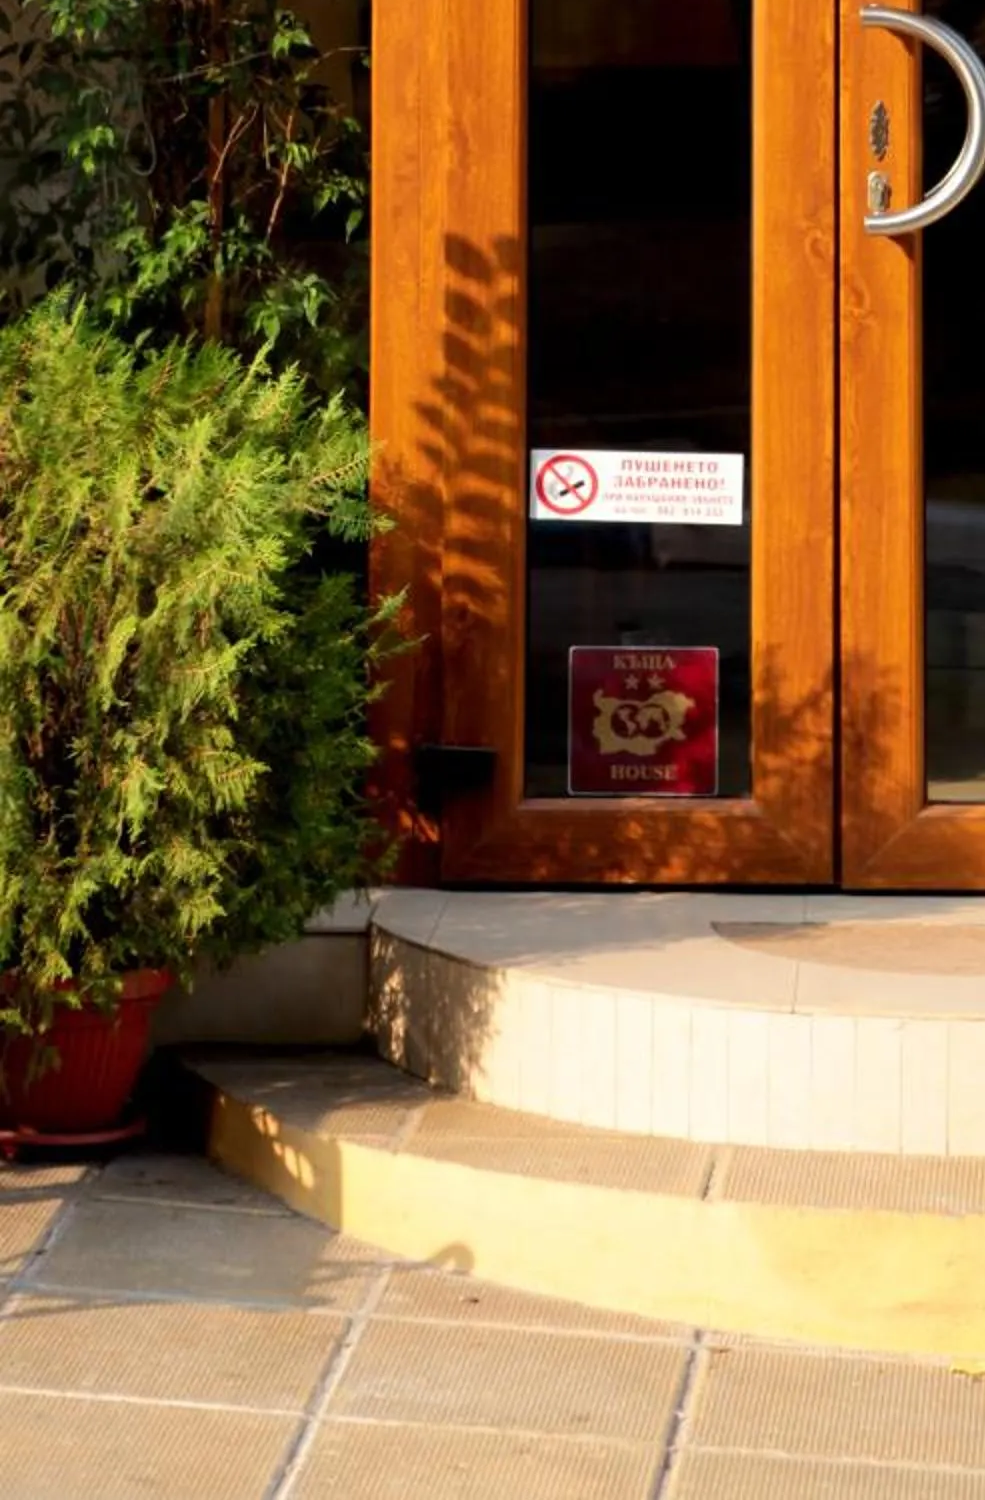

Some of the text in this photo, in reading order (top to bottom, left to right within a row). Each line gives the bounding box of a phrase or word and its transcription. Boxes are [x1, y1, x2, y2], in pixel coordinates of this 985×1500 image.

[620, 458, 719, 474] ПУШЕНЕТО
[613, 474, 727, 491] ЗАБРАНЕНО!
[610, 764, 679, 781] HOUSE
